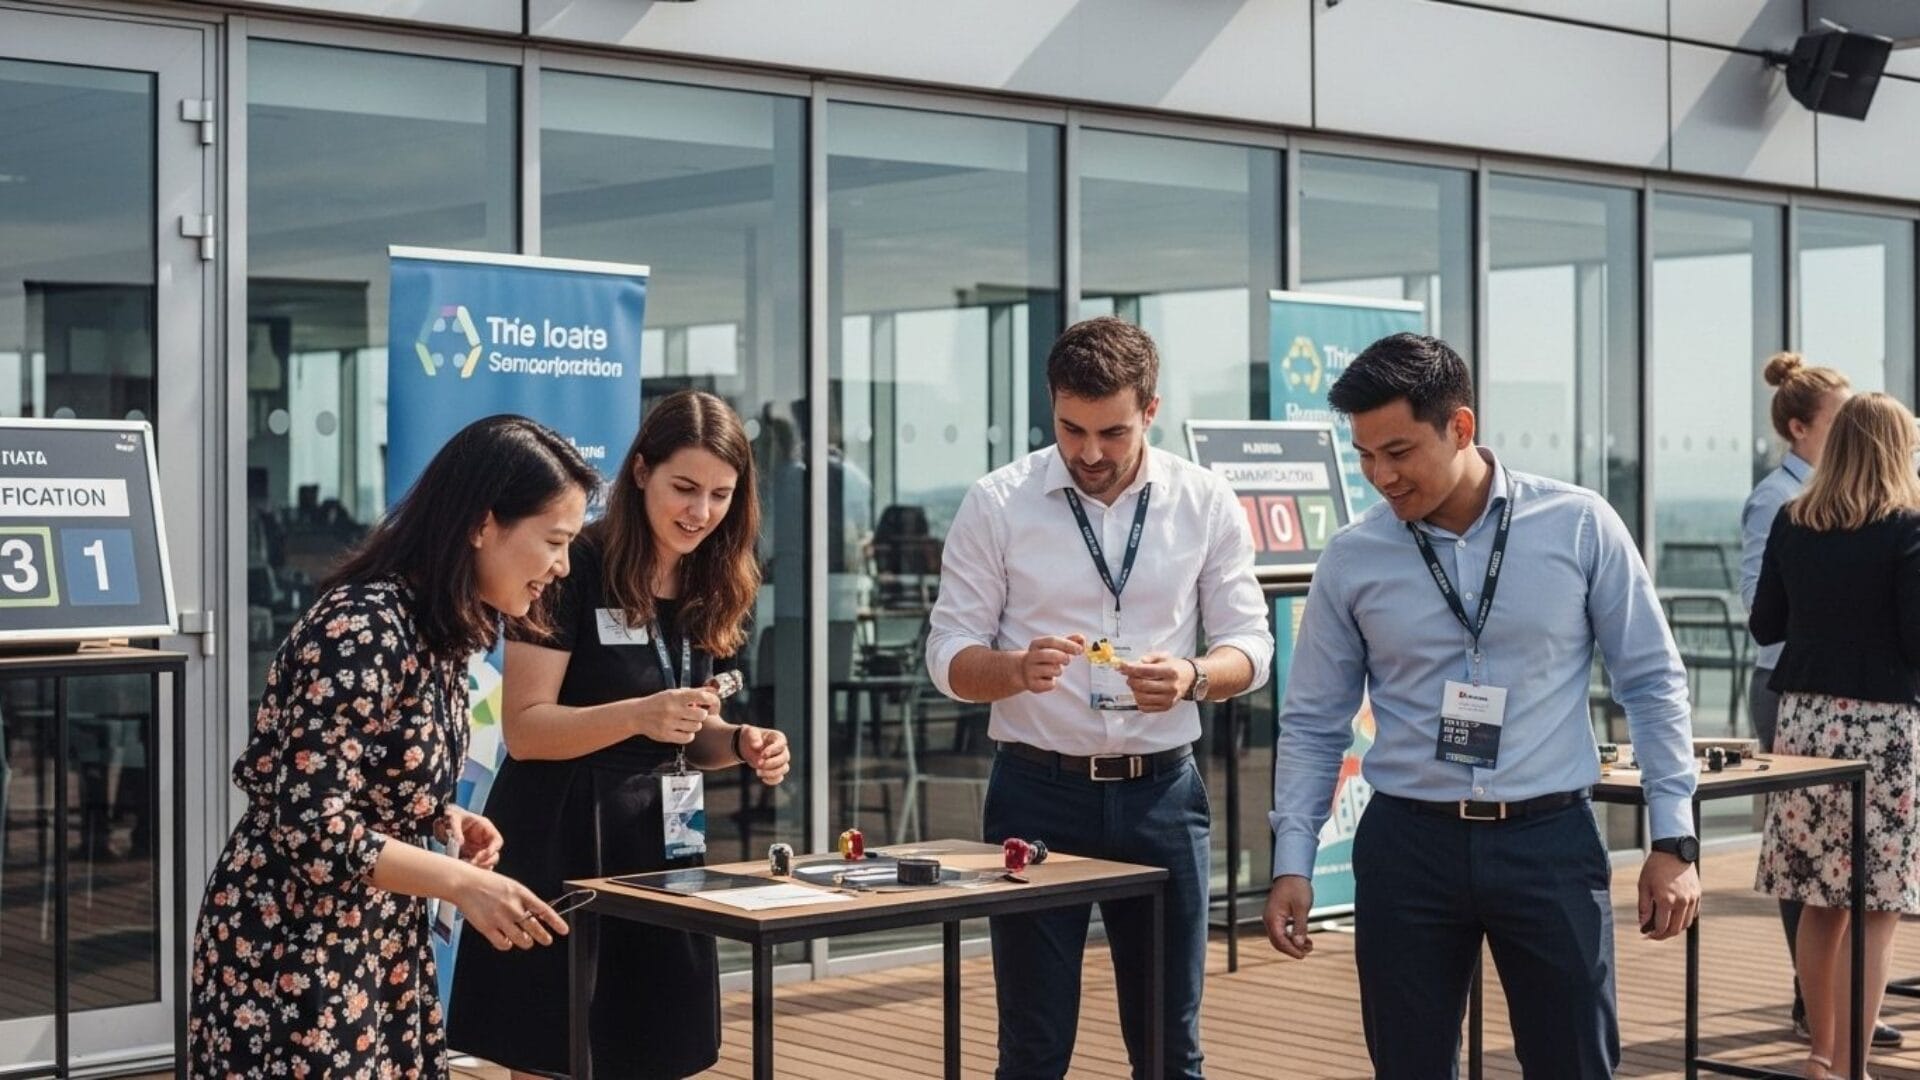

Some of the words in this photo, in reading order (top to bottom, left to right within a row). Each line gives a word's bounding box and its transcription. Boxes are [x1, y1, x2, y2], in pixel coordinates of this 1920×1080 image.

[1, 486, 107, 507] FICATION
[1270, 503, 1293, 542] 0
[1308, 505, 1326, 540] 7
[0, 538, 39, 593] 3
[83, 539, 110, 591] 1
